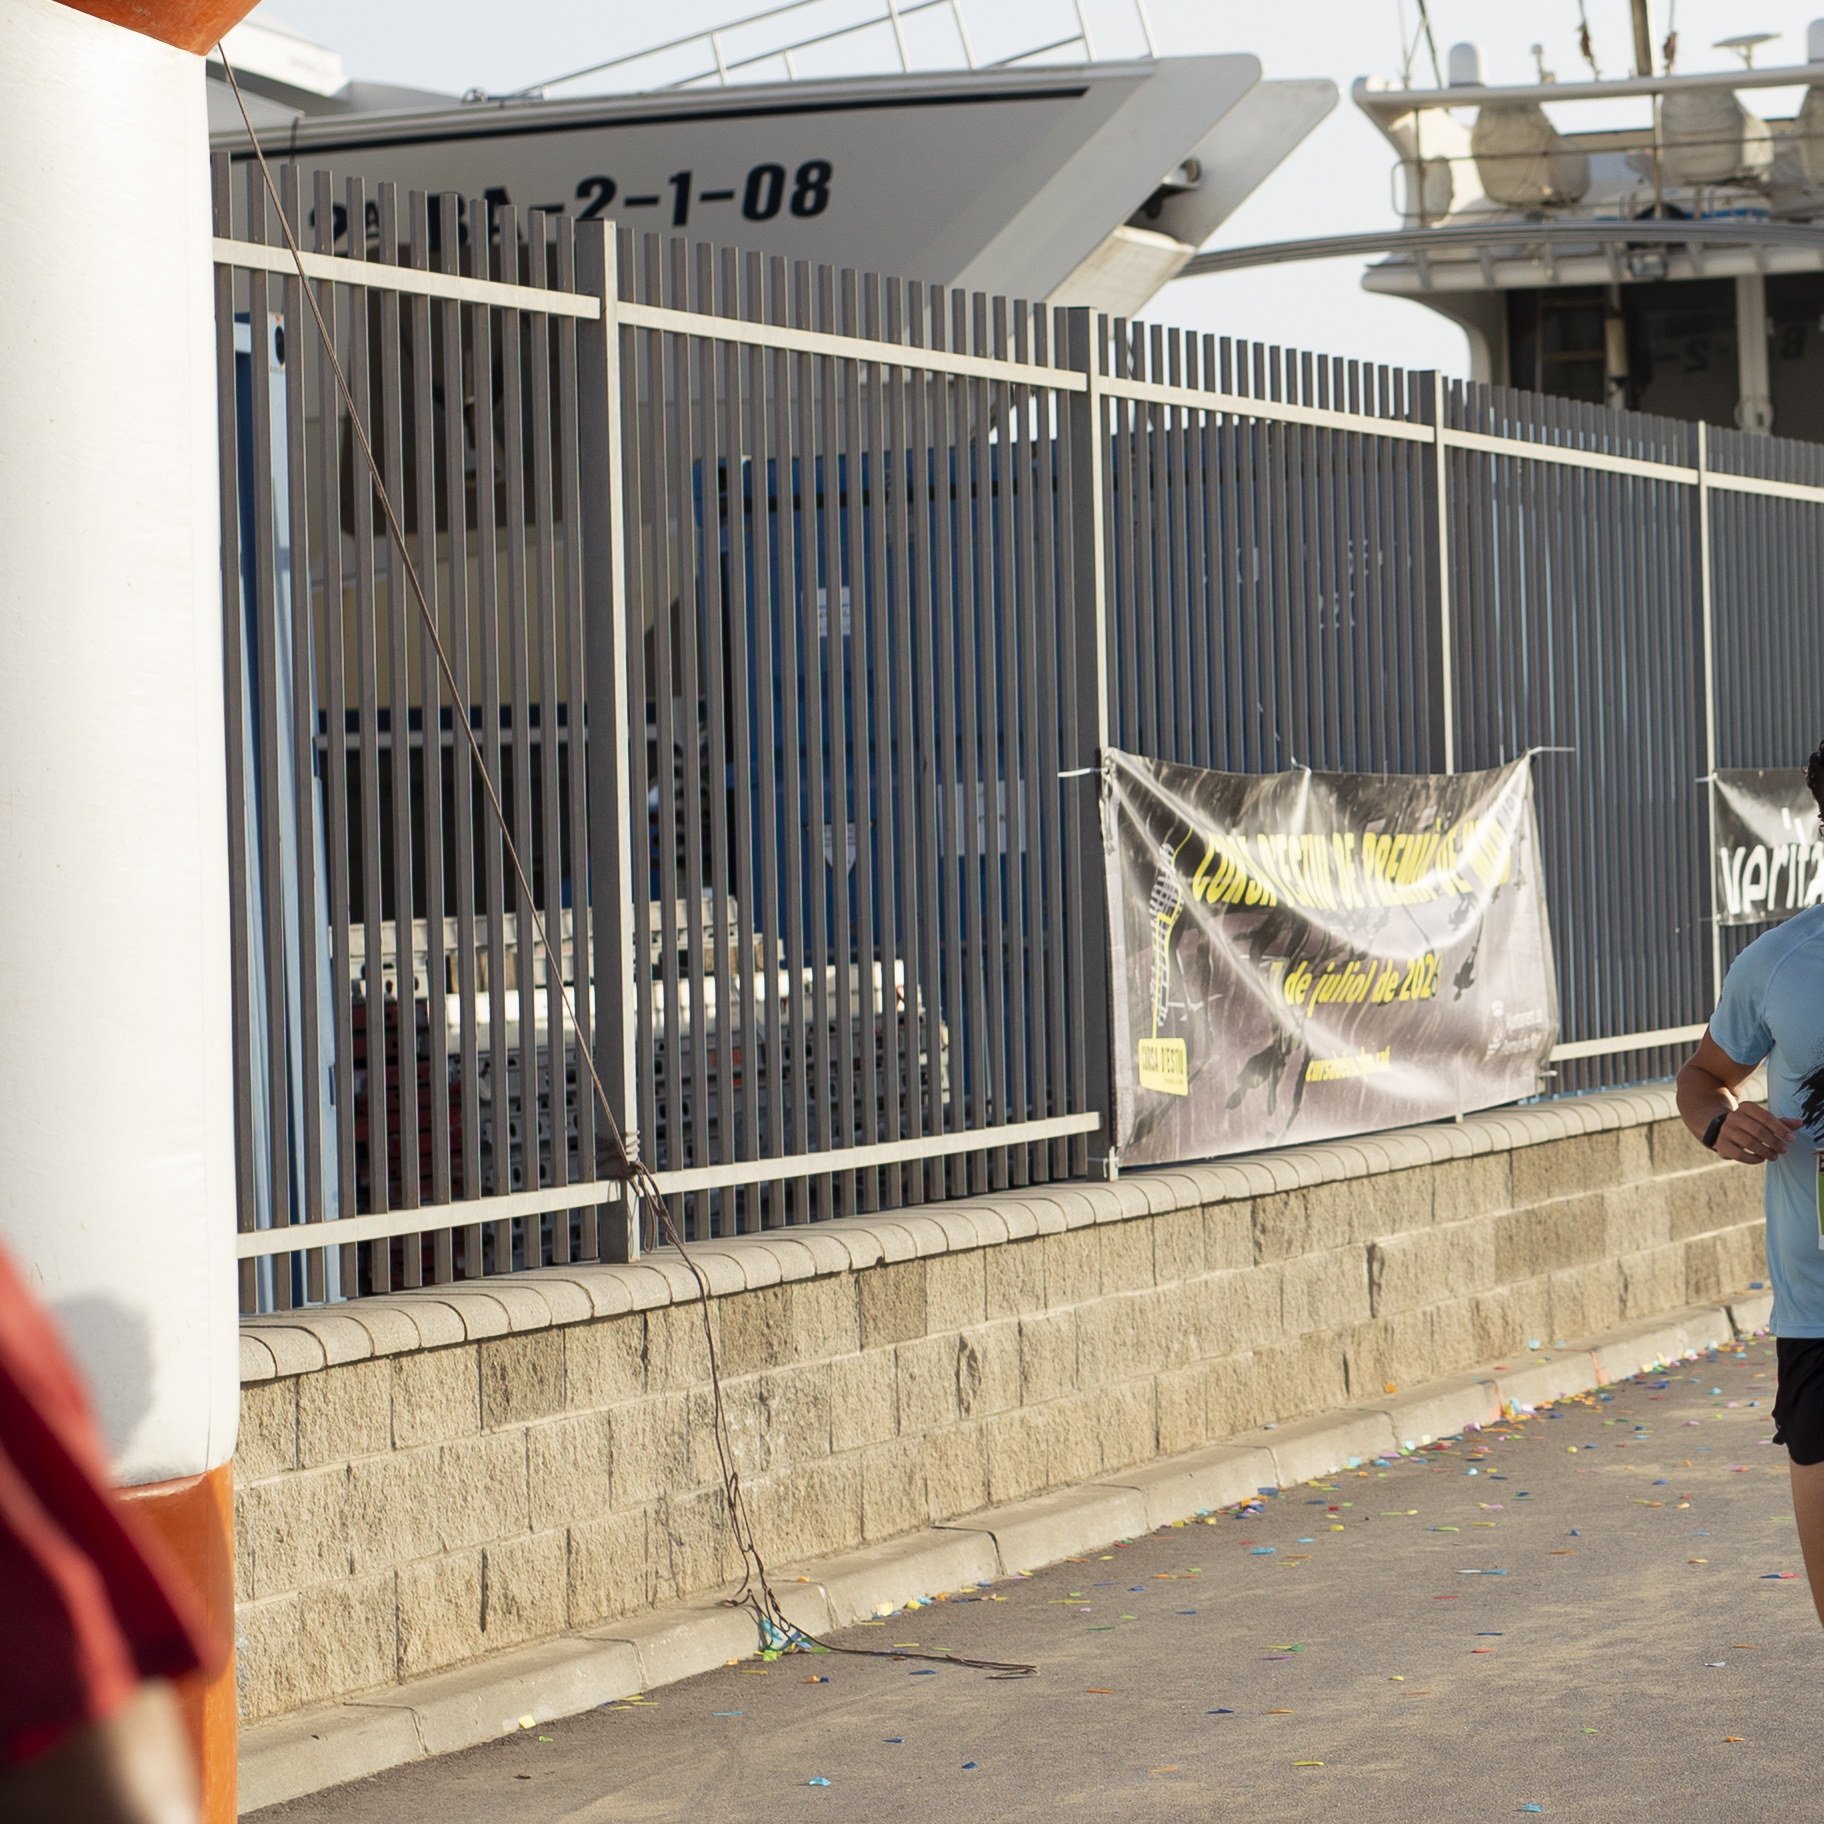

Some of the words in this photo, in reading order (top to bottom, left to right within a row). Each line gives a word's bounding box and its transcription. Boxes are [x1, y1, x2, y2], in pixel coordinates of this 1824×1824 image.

[1283, 960, 1313, 1006] de
[1306, 960, 1378, 1018] juliol
[1370, 958, 1400, 1003] de
